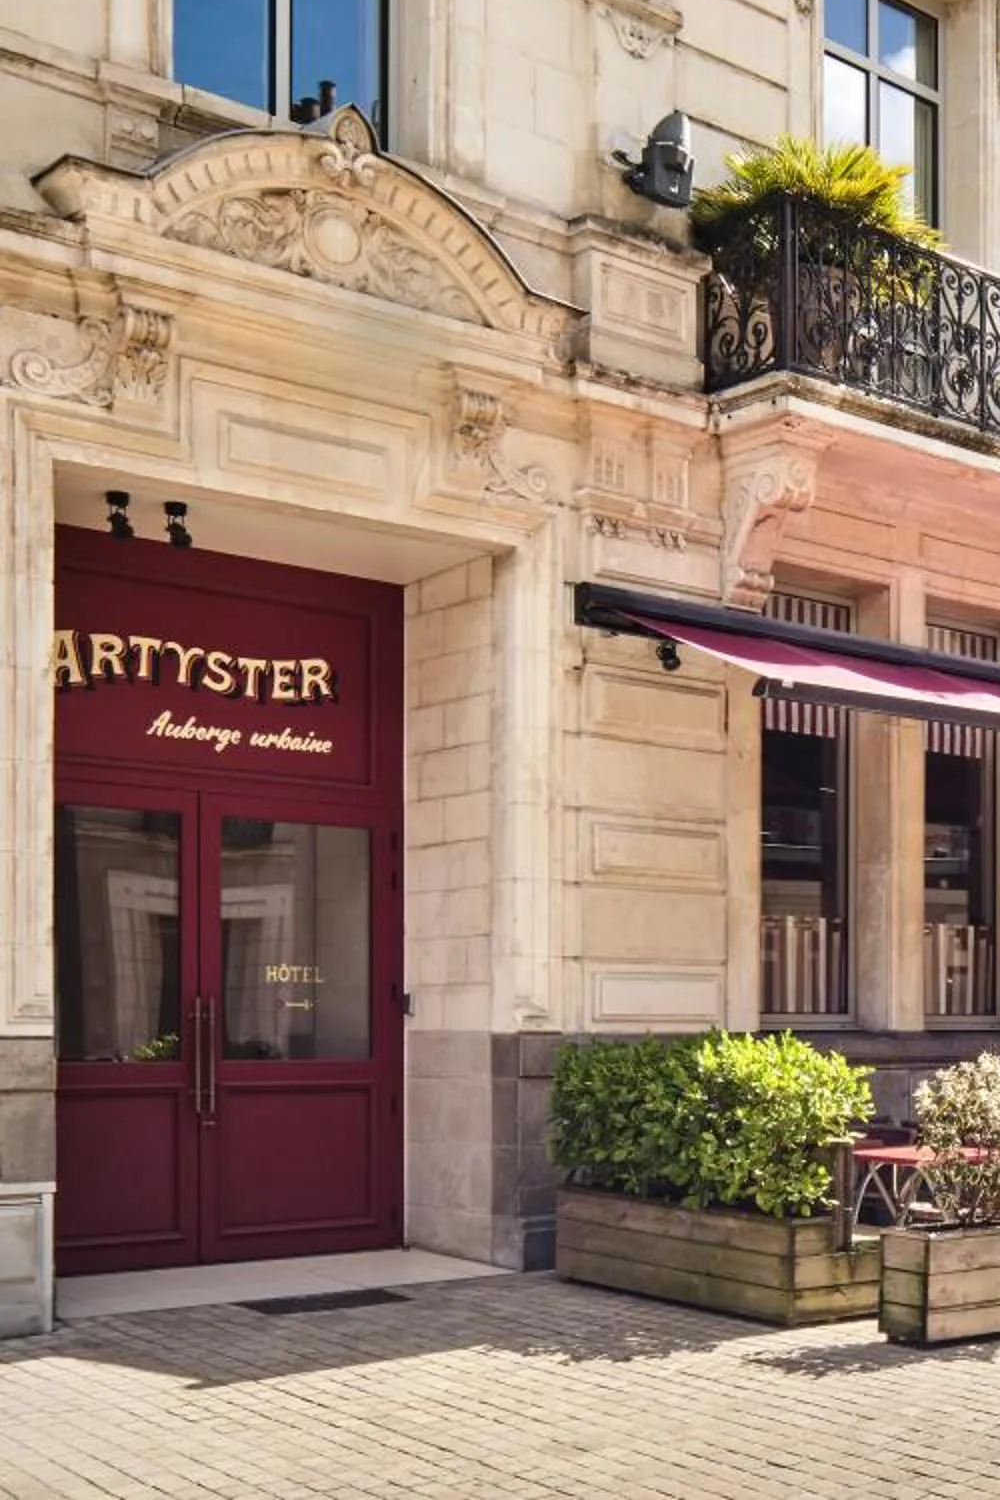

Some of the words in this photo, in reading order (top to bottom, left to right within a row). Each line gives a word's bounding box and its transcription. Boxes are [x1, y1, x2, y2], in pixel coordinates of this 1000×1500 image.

[54, 629, 336, 701] ARTYSTER
[146, 709, 242, 752] Auberge
[250, 727, 334, 754] urbaine
[265, 963, 325, 983] HÔTEL
